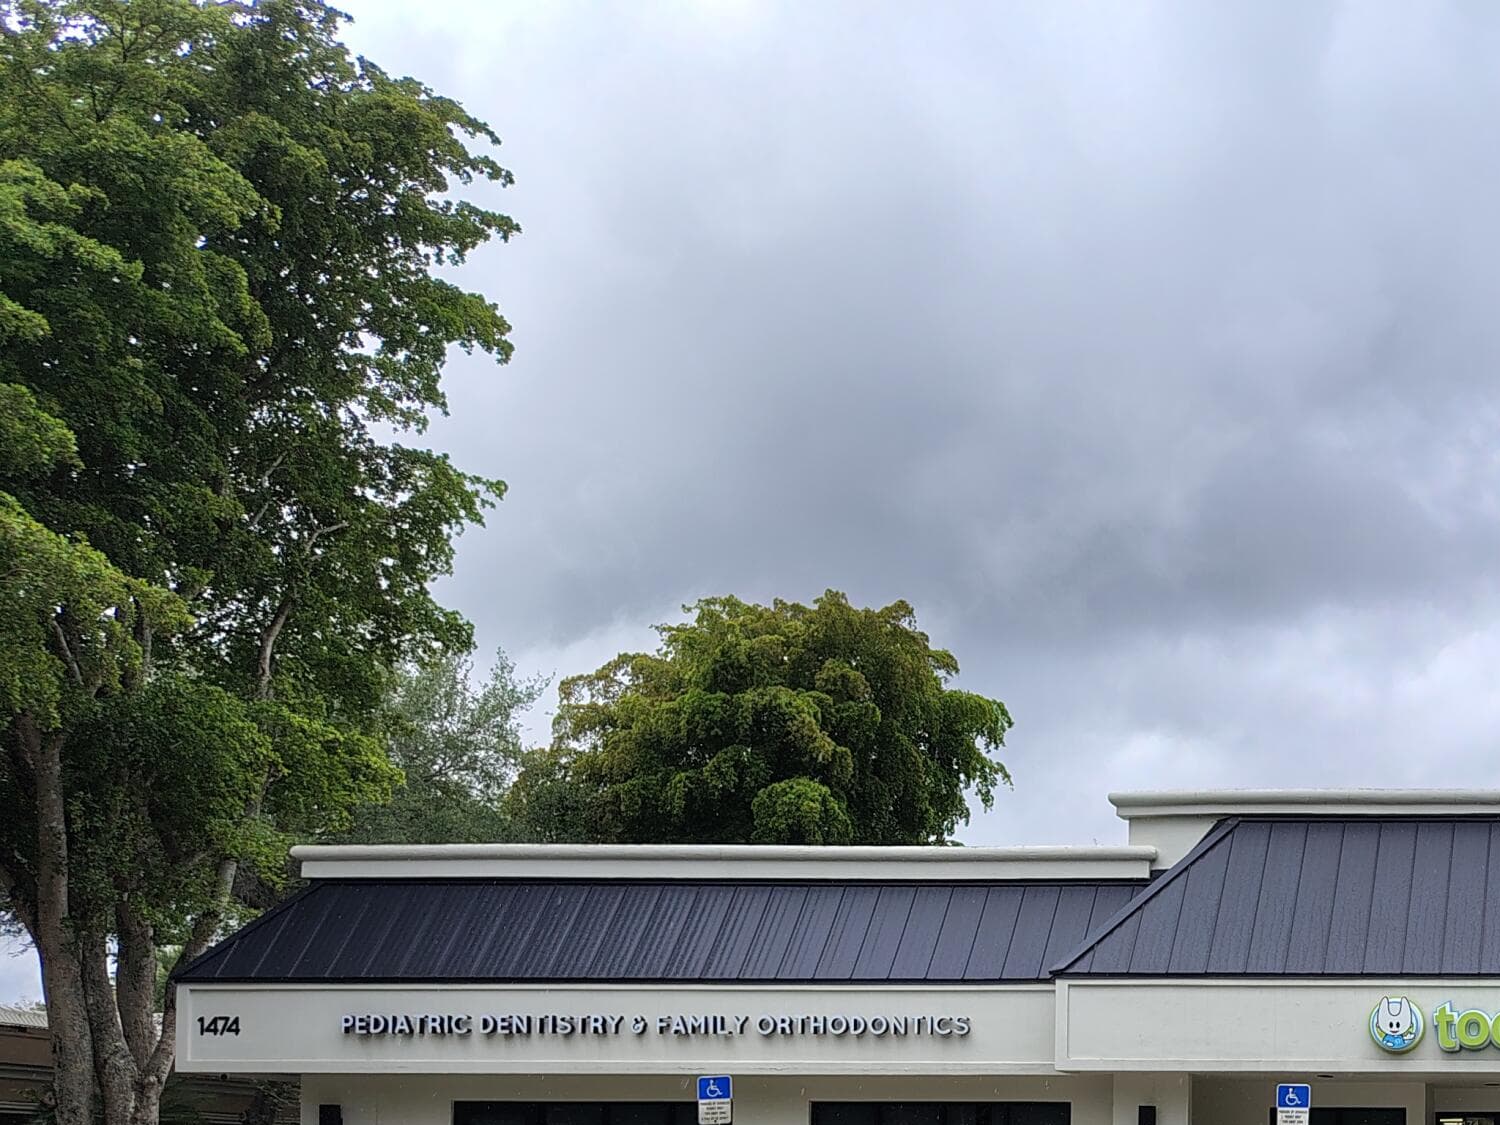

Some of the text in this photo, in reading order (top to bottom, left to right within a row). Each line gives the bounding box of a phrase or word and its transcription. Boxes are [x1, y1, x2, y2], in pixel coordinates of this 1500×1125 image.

[197, 1016, 241, 1036] 1474
[341, 1015, 971, 1036] PEDIATRIC DENTISTRY & FAMILY ORTHODONTICS
